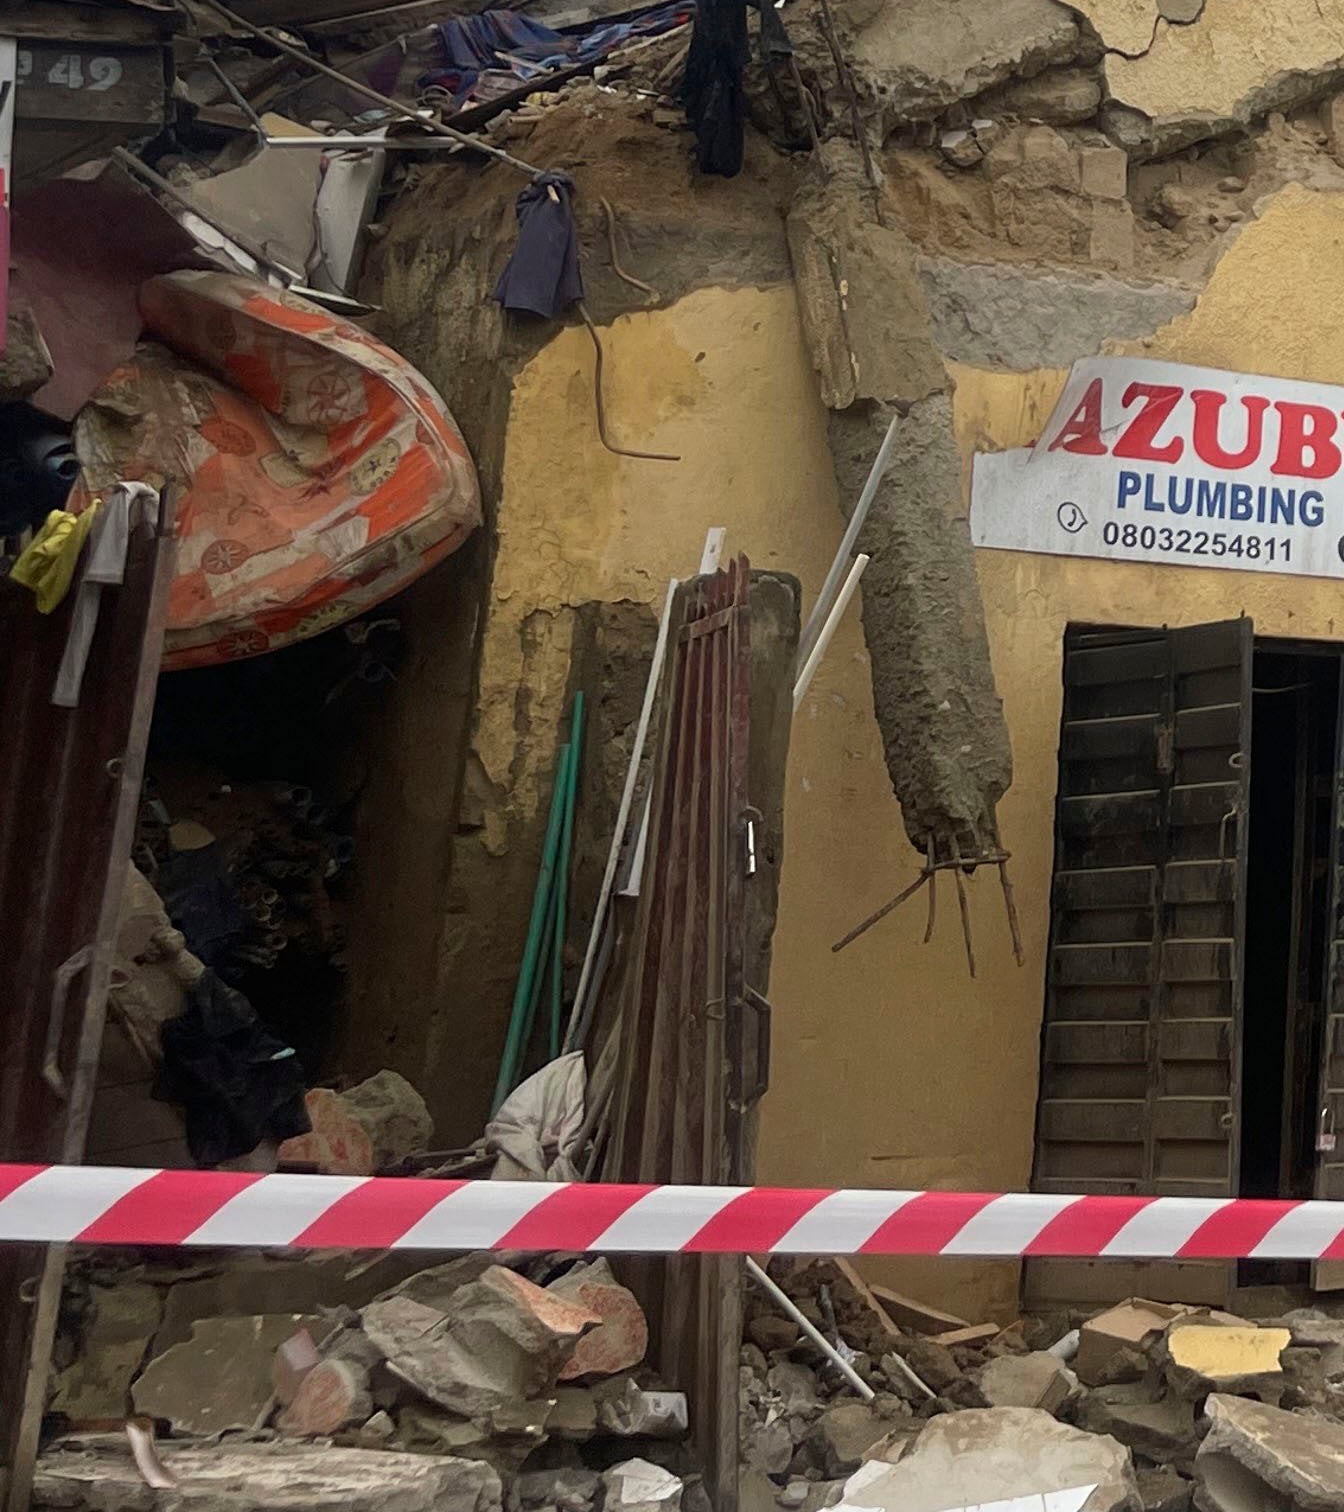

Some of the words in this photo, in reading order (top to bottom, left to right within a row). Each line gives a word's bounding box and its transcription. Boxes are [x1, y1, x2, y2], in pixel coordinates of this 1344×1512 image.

[48, 54, 123, 91] 49
[1116, 470, 1325, 528] PLUMBING
[1103, 521, 1292, 562] 08032254811
